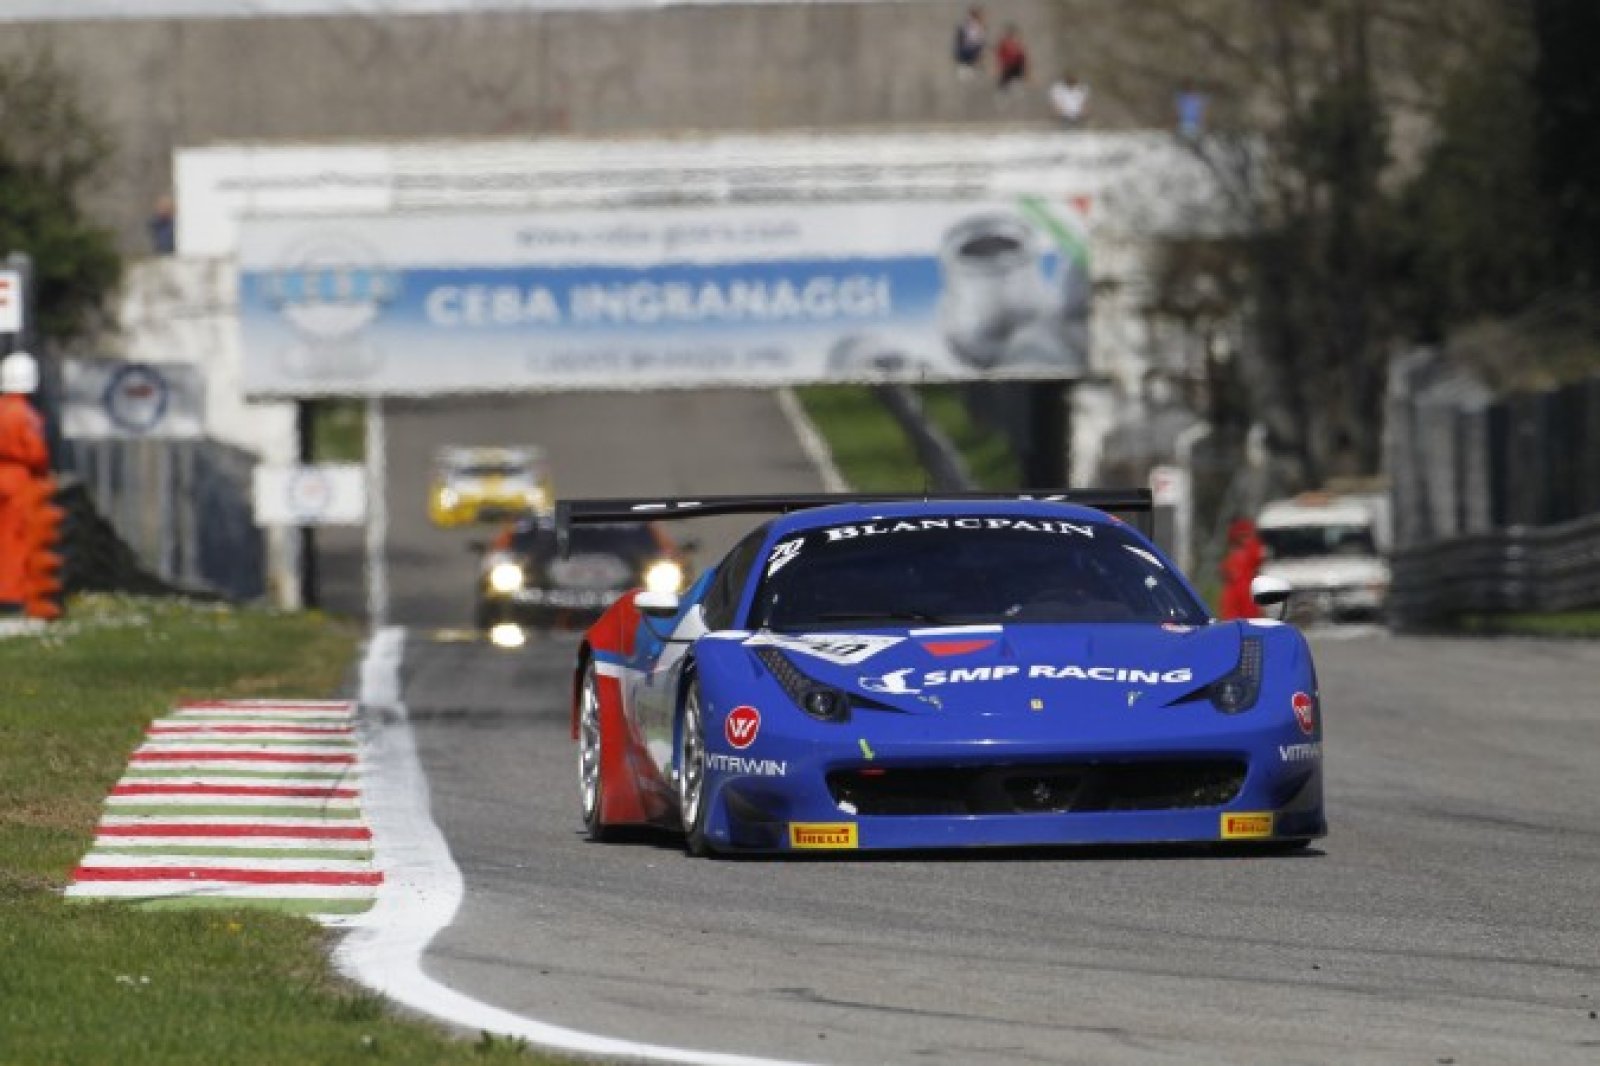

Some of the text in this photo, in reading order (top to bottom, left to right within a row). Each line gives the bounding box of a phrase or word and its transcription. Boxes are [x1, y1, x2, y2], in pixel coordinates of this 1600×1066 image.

[426, 284, 560, 326] CEBA
[568, 275, 891, 323] INGRANAGGI
[825, 517, 1096, 541] BLANCPAIN
[923, 664, 1193, 687] SMP RACING
[793, 826, 850, 845] PIRELLI
